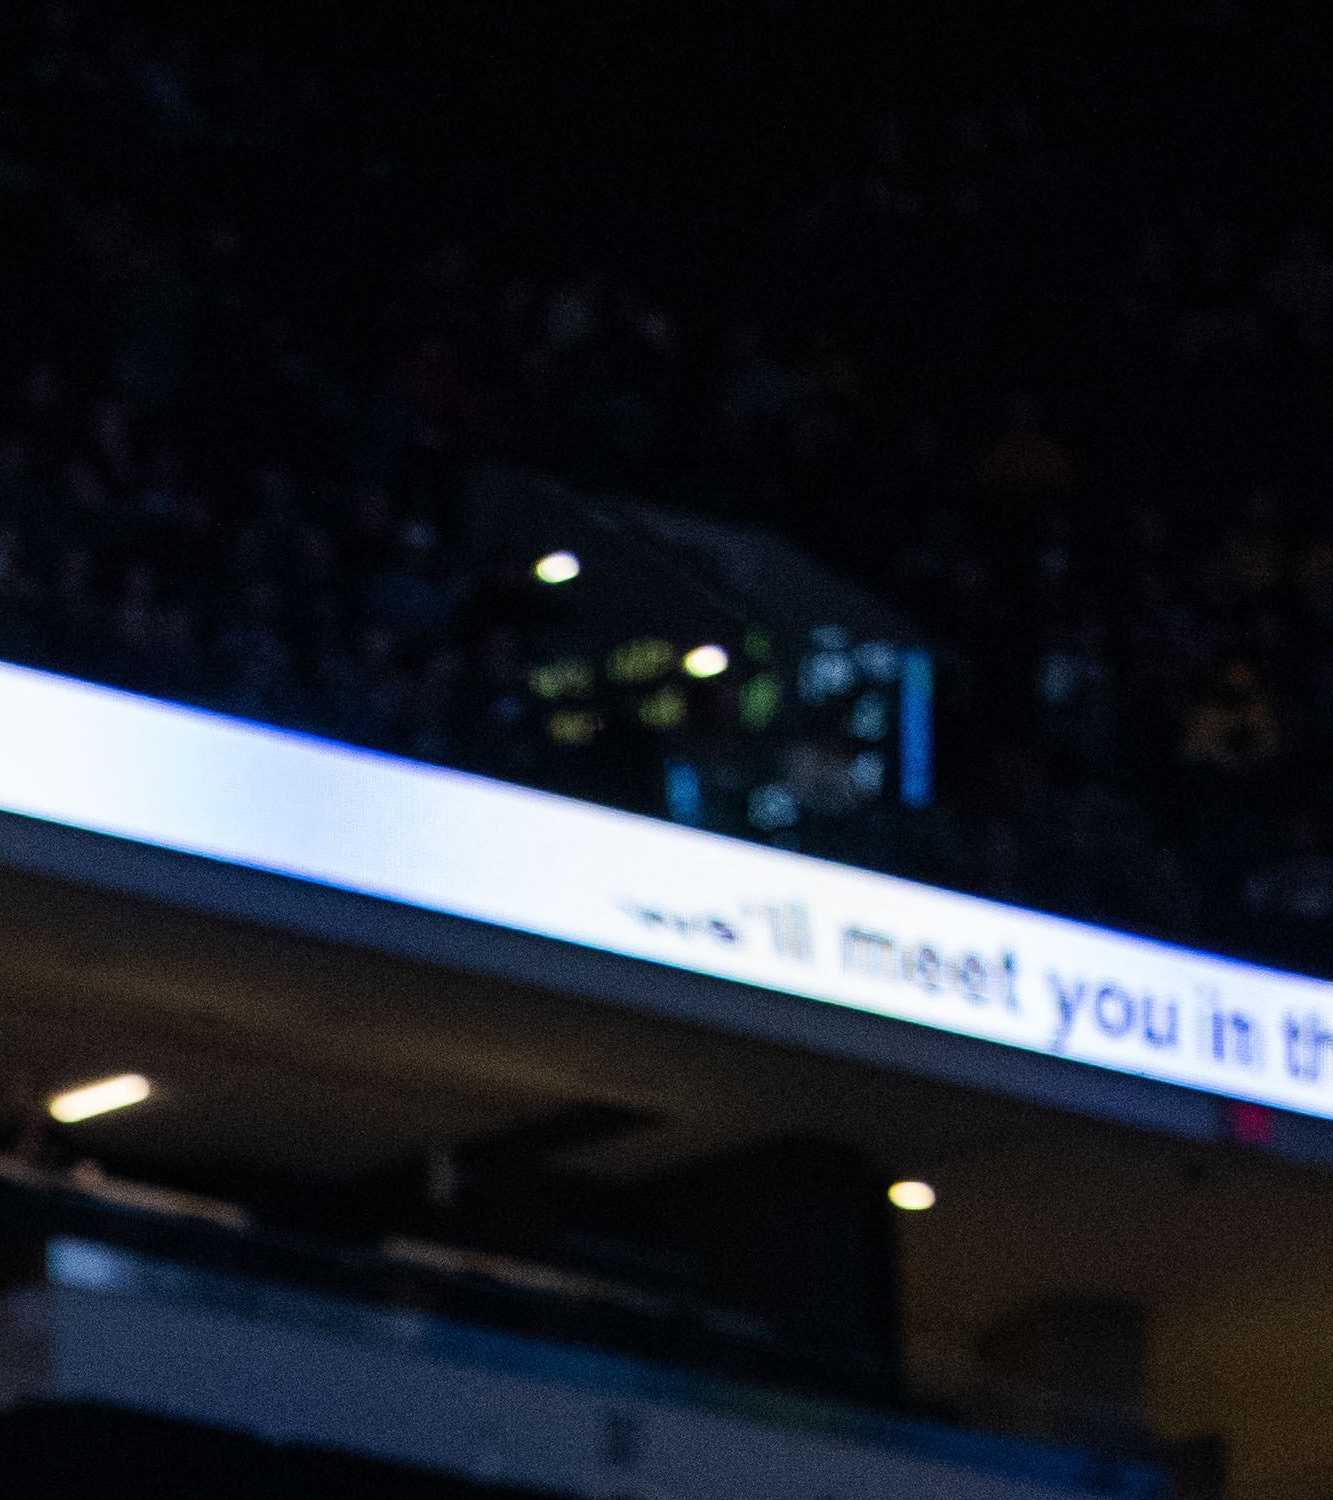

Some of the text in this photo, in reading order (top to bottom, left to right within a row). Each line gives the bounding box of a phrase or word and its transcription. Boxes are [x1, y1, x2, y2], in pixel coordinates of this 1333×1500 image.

[841, 925, 1020, 1015] meet
[1046, 970, 1180, 1056] you
[1210, 988, 1256, 1066] in
